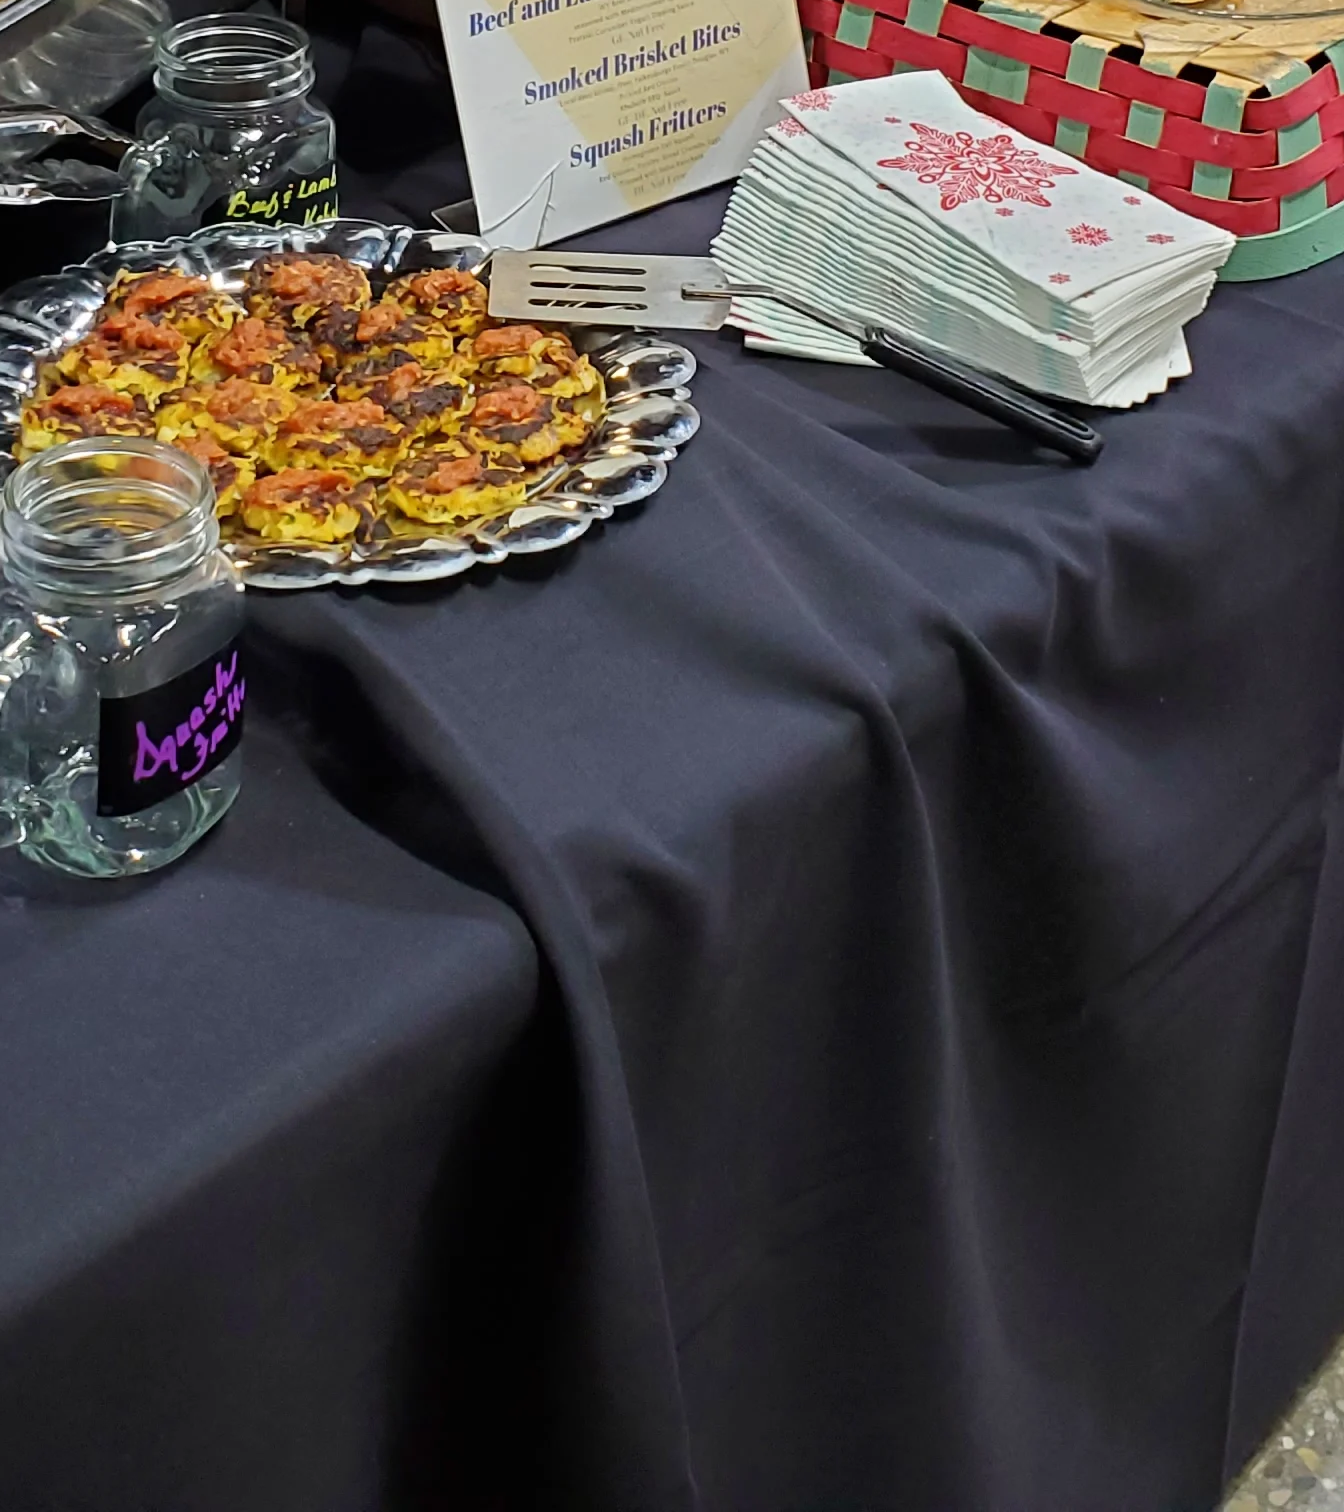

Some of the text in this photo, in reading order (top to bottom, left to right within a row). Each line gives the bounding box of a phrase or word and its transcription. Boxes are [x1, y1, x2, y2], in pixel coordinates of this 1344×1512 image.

[524, 56, 608, 104] Smoked
[614, 35, 685, 76] Brisket
[692, 22, 740, 51] Bites
[570, 123, 643, 168] Squash
[649, 101, 726, 140] Fritters
